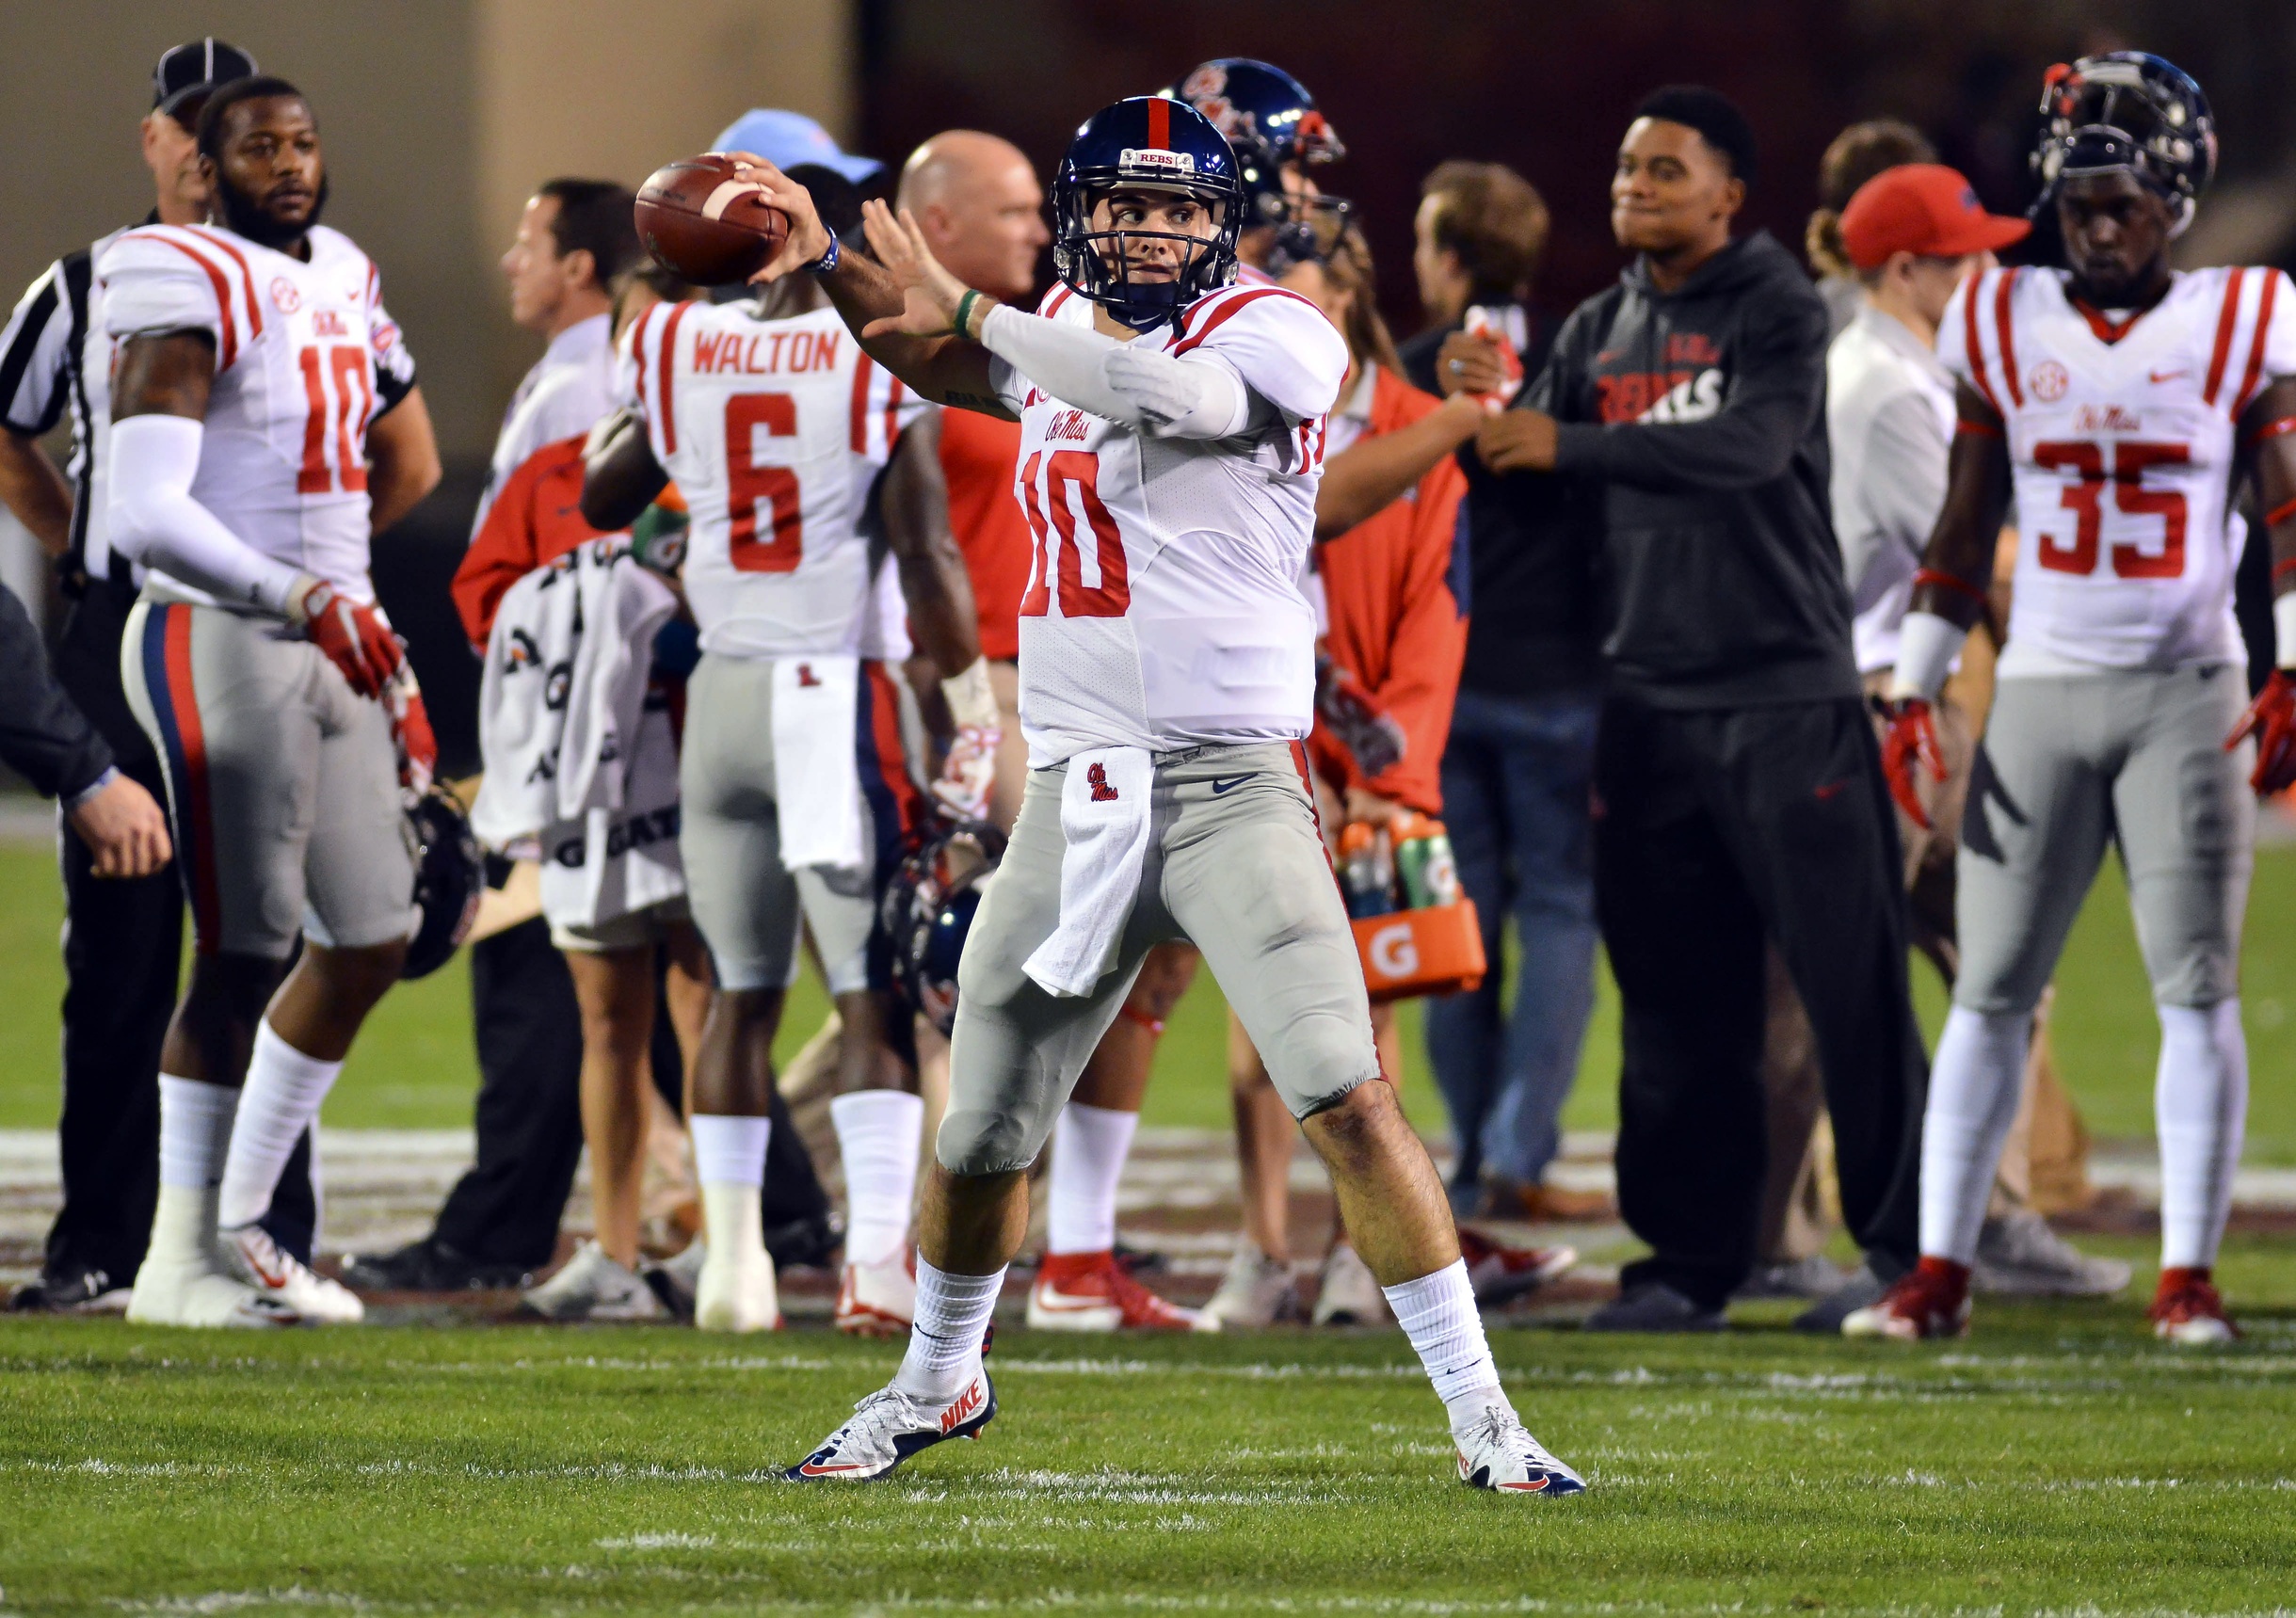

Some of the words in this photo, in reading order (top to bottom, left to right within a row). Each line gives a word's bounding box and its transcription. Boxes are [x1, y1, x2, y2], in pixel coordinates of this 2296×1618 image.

[1140, 153, 1173, 164] REBS
[693, 329, 841, 374] WALTON
[297, 345, 372, 493] 10
[1045, 411, 1061, 442] Ole
[1058, 409, 1091, 441] Miss
[725, 392, 802, 572] 6
[2033, 440, 2191, 579] 35
[1018, 450, 1131, 618] 10
[1087, 762, 1106, 783] Ole
[1091, 782, 1118, 802] Miss
[1370, 921, 1420, 978] G
[940, 1377, 983, 1435] NIKE
